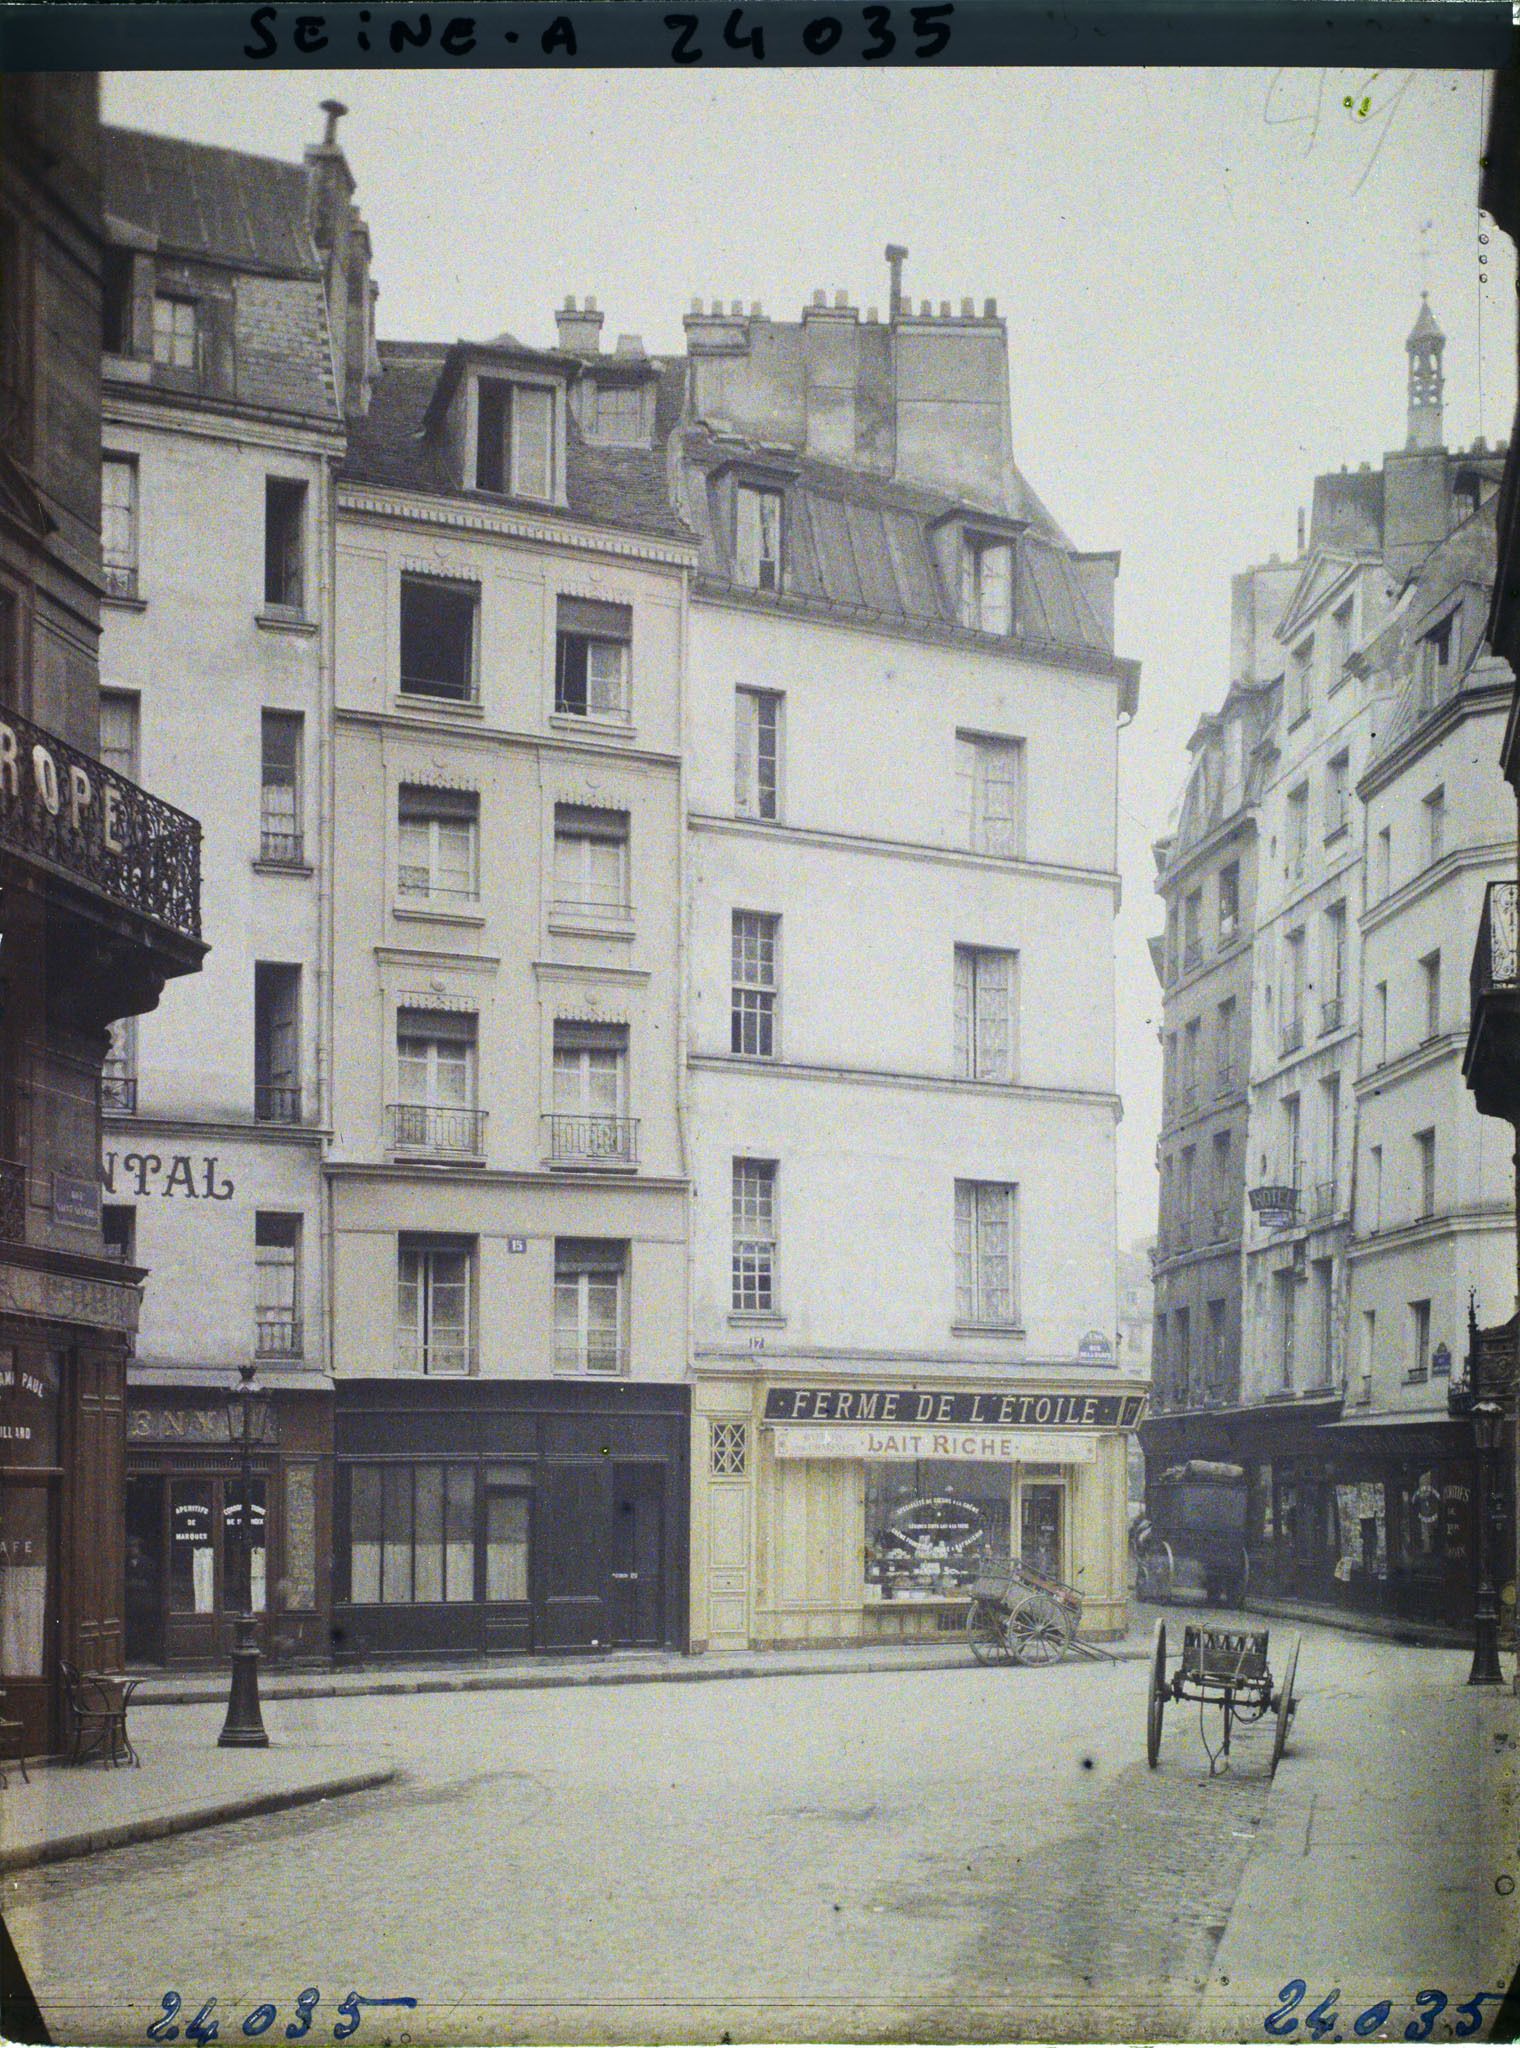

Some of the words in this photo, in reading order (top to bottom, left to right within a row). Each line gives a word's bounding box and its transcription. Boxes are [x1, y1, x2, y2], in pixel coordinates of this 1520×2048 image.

[22, 1372, 43, 1398] PAUL
[791, 1390, 900, 1420] FERME
[915, 1394, 955, 1422] DE
[868, 1433, 922, 1453] LAIT
[932, 1433, 1012, 1456] RICHE
